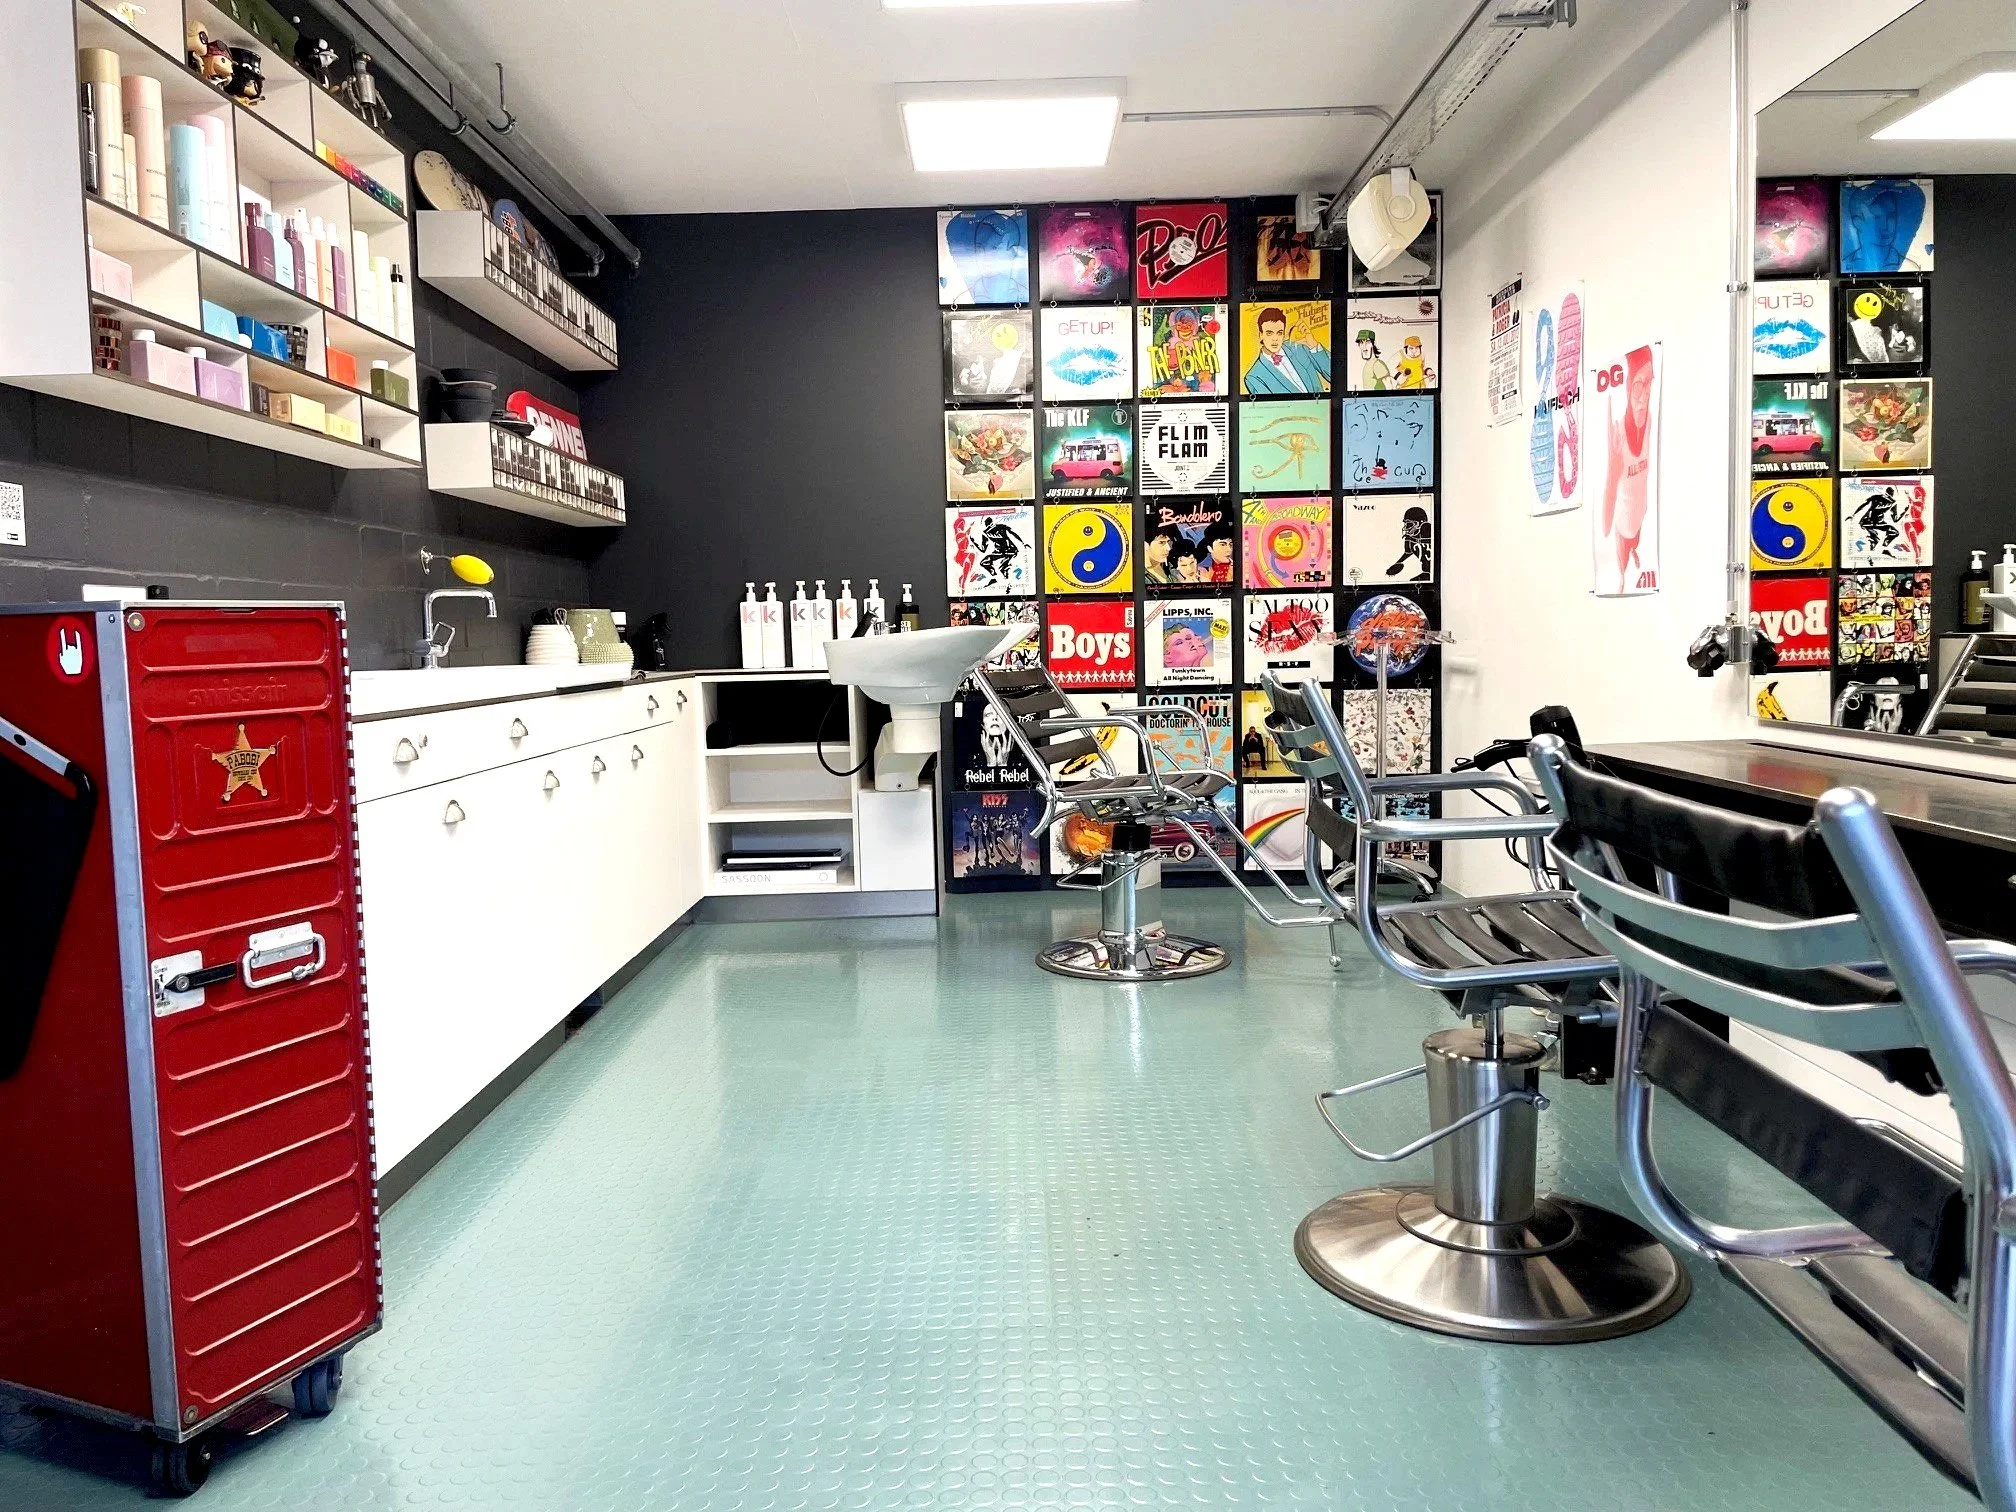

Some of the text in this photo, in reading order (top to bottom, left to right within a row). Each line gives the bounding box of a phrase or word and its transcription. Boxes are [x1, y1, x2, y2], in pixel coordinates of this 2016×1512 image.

[1058, 320, 1114, 335] GET UP!
[1146, 336, 1220, 384] THE POWER
[1044, 407, 1090, 427] The KLF
[1158, 425, 1208, 441] FLIM
[1158, 442, 1208, 458] FLAM
[1046, 486, 1129, 498] JUSTIFIED & ANCIENT
[1158, 501, 1223, 527] Bandolero
[742, 605, 756, 623] k
[763, 605, 776, 623] k
[792, 603, 806, 621] k
[812, 603, 826, 620] k
[839, 602, 852, 620] k
[1163, 607, 1213, 617] LIPPS, INC.
[1286, 597, 1328, 614] TOO
[1050, 624, 1131, 665] Boys
[1207, 717, 1231, 728] HOUSE
[965, 767, 1029, 783] Rebel Rebel
[982, 792, 1008, 806] KISS
[721, 873, 771, 884] SASSOON
